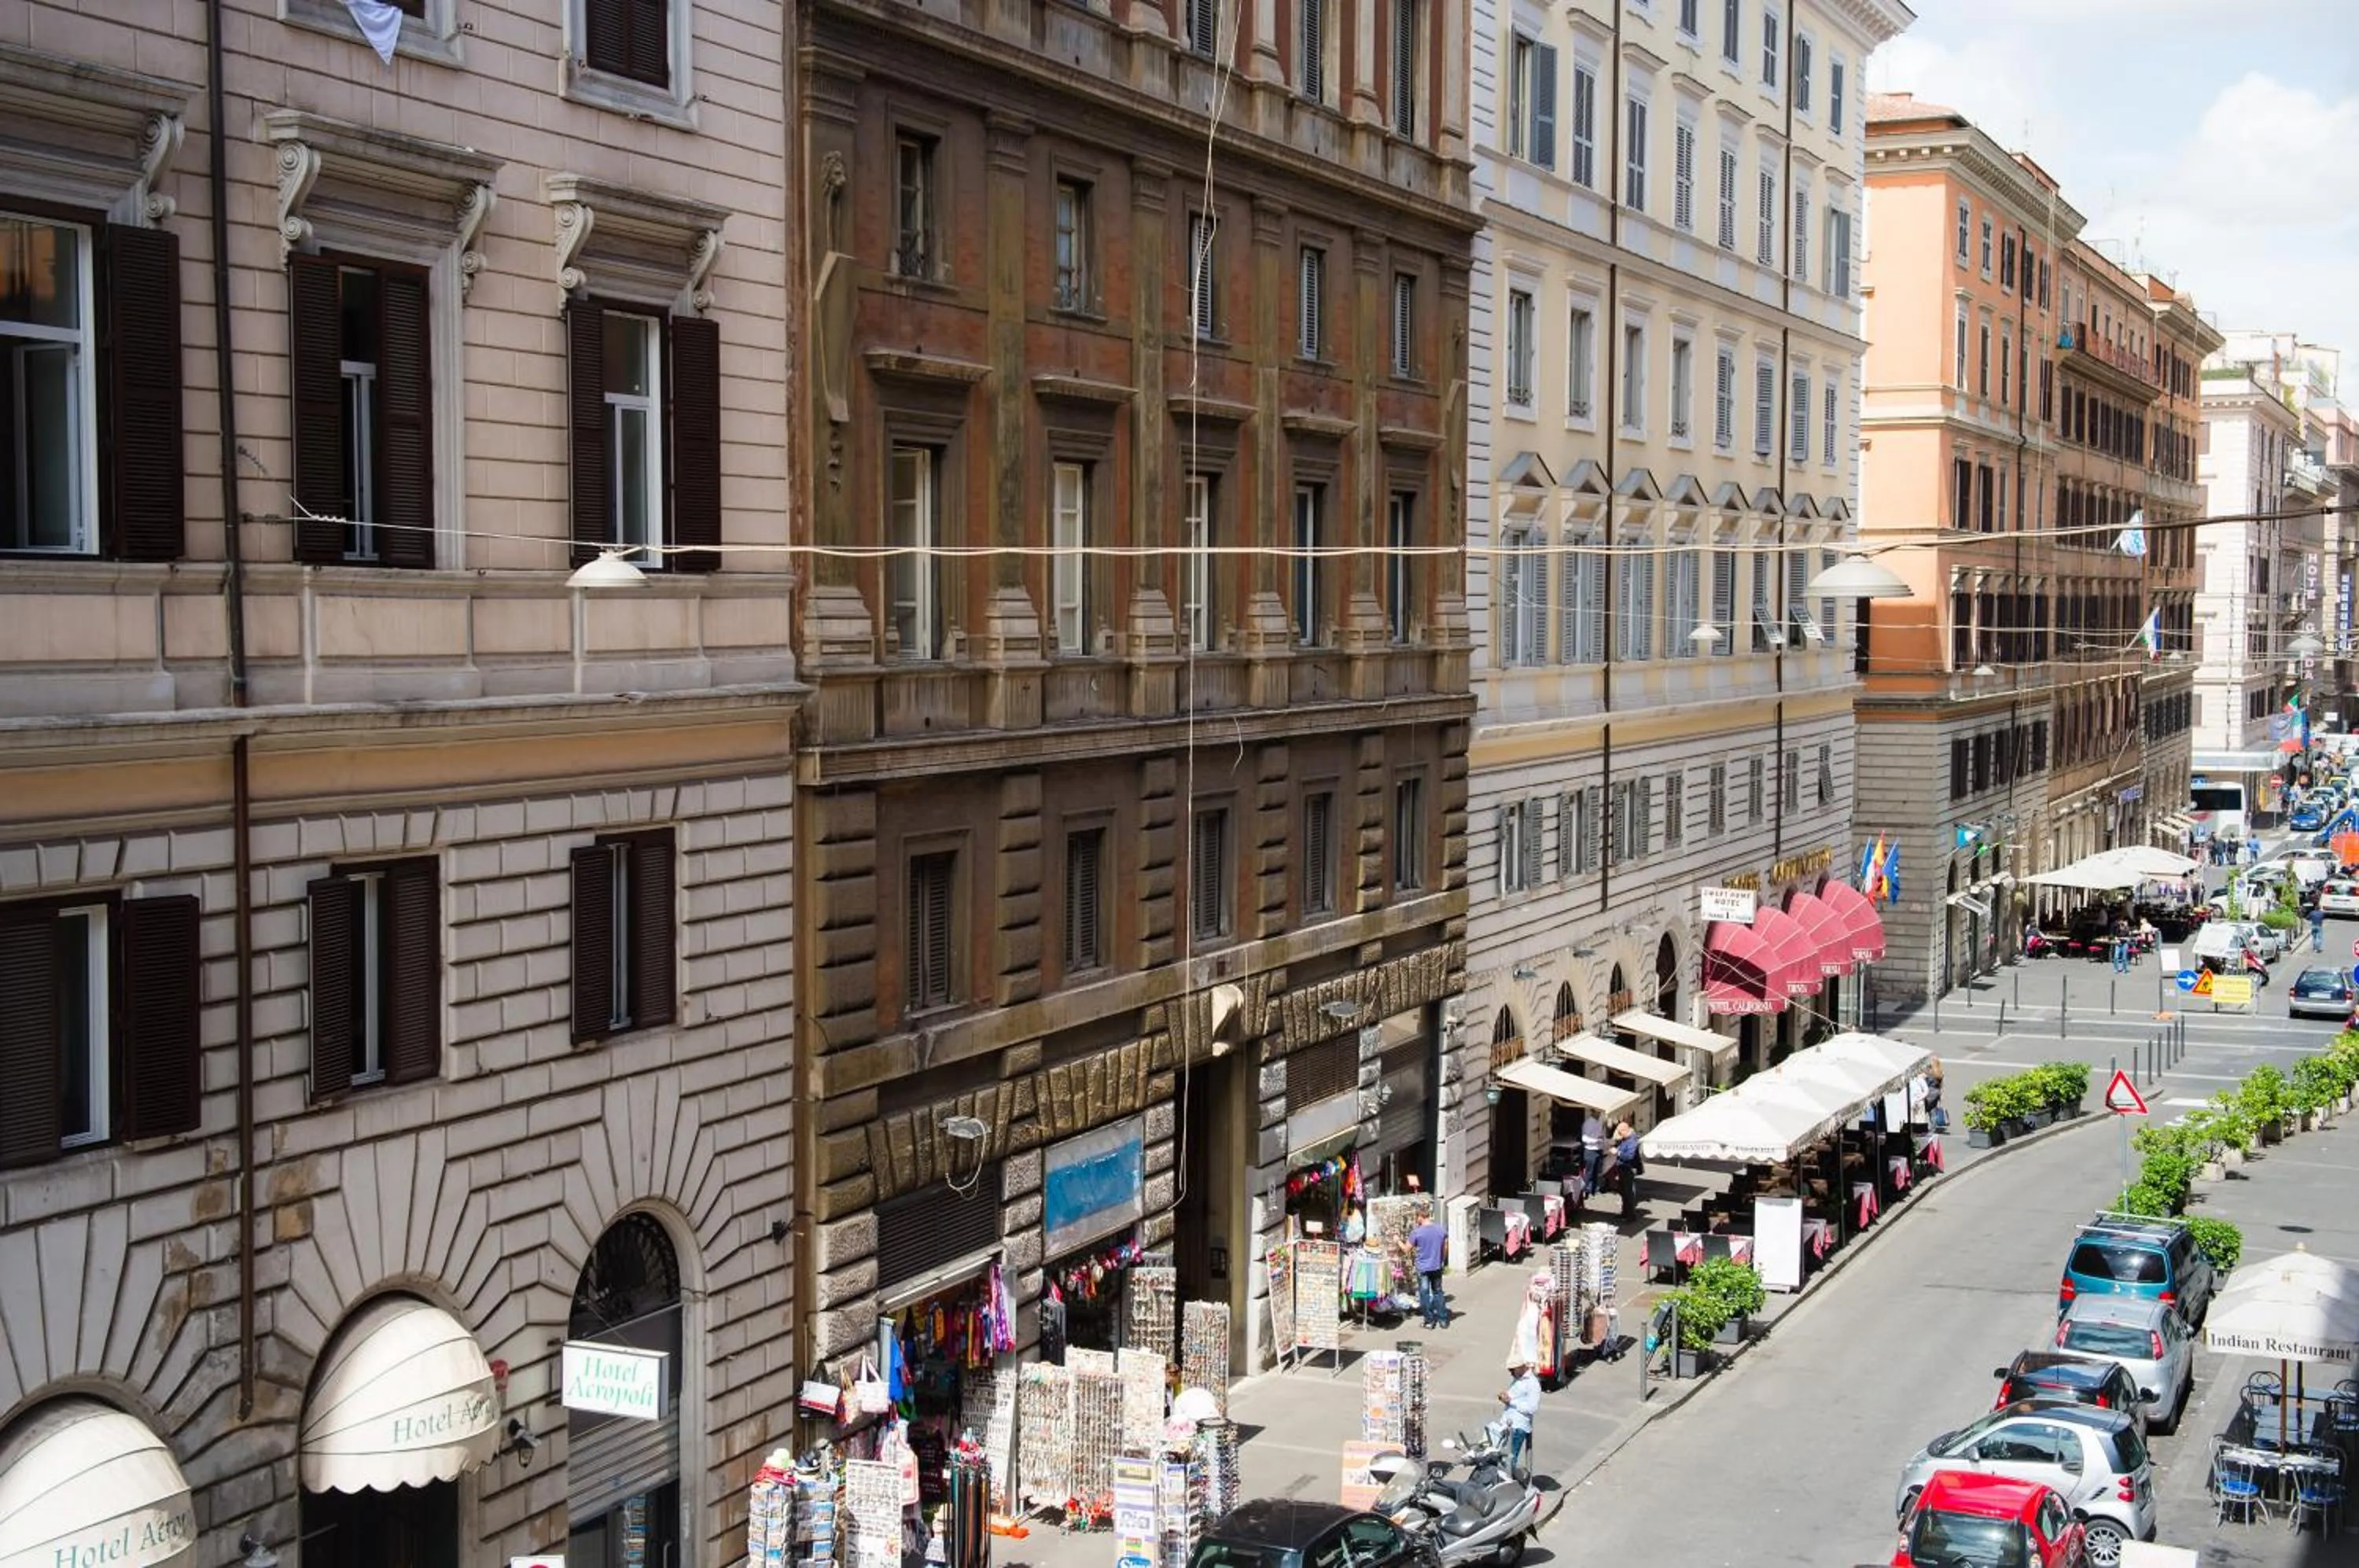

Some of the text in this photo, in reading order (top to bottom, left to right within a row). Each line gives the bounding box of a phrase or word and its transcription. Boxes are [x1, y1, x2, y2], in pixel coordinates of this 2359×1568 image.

[2211, 1333, 2351, 1360] Indian Restaurant
[584, 1356, 642, 1383] Hotel
[567, 1375, 654, 1412] Acropoli
[393, 1403, 452, 1444] Hotel
[54, 1527, 130, 1568] Hotel
